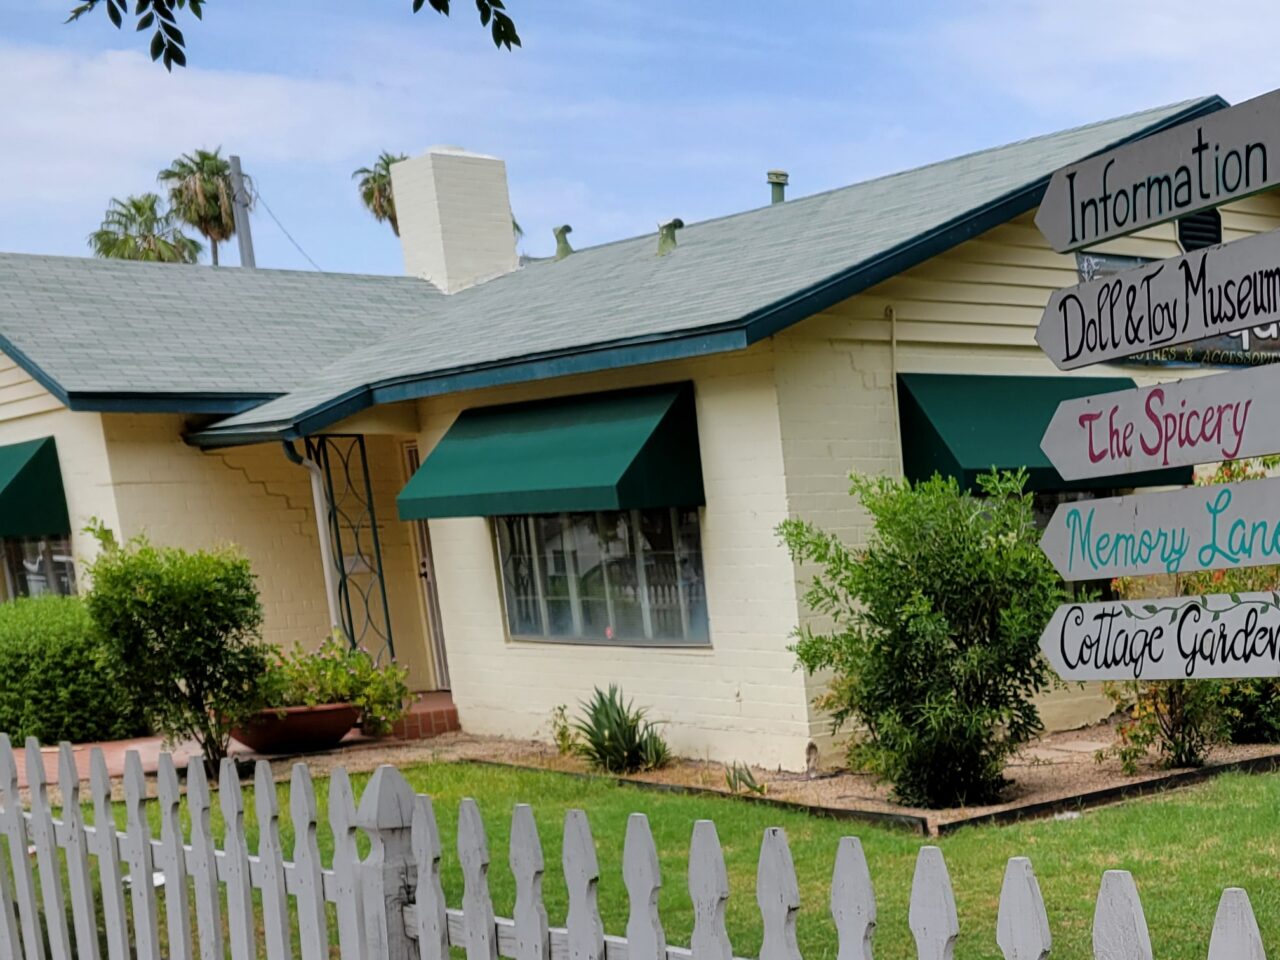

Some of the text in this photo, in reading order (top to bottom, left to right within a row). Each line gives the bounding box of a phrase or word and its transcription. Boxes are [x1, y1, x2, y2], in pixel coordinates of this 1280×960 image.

[1066, 127, 1268, 245] Information
[1078, 388, 1252, 466] The Spicery
[1066, 507, 1190, 574] Memory
[1060, 606, 1165, 679] Cottage
